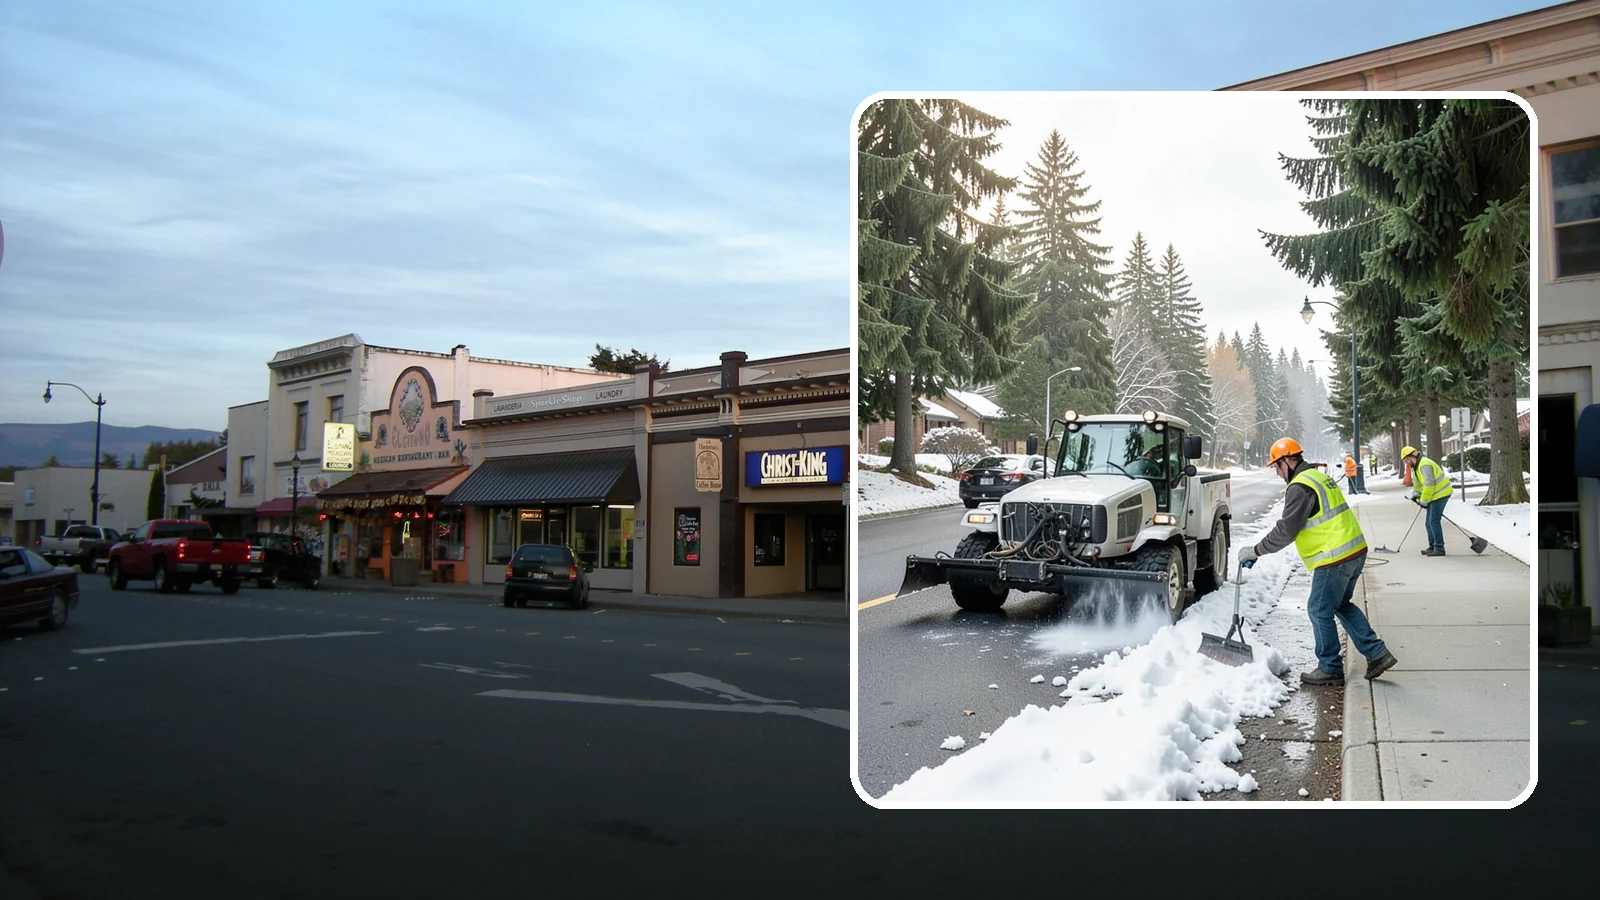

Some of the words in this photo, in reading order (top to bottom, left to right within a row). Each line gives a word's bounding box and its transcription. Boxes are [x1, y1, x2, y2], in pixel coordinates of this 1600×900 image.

[595, 389, 623, 400] LAUNDRY
[494, 402, 523, 412] LAVANDERIA
[374, 455, 396, 464] MEXICAN
[397, 451, 434, 462] RESTAURANT
[437, 450, 450, 459] BAR
[799, 450, 827, 477] KING
